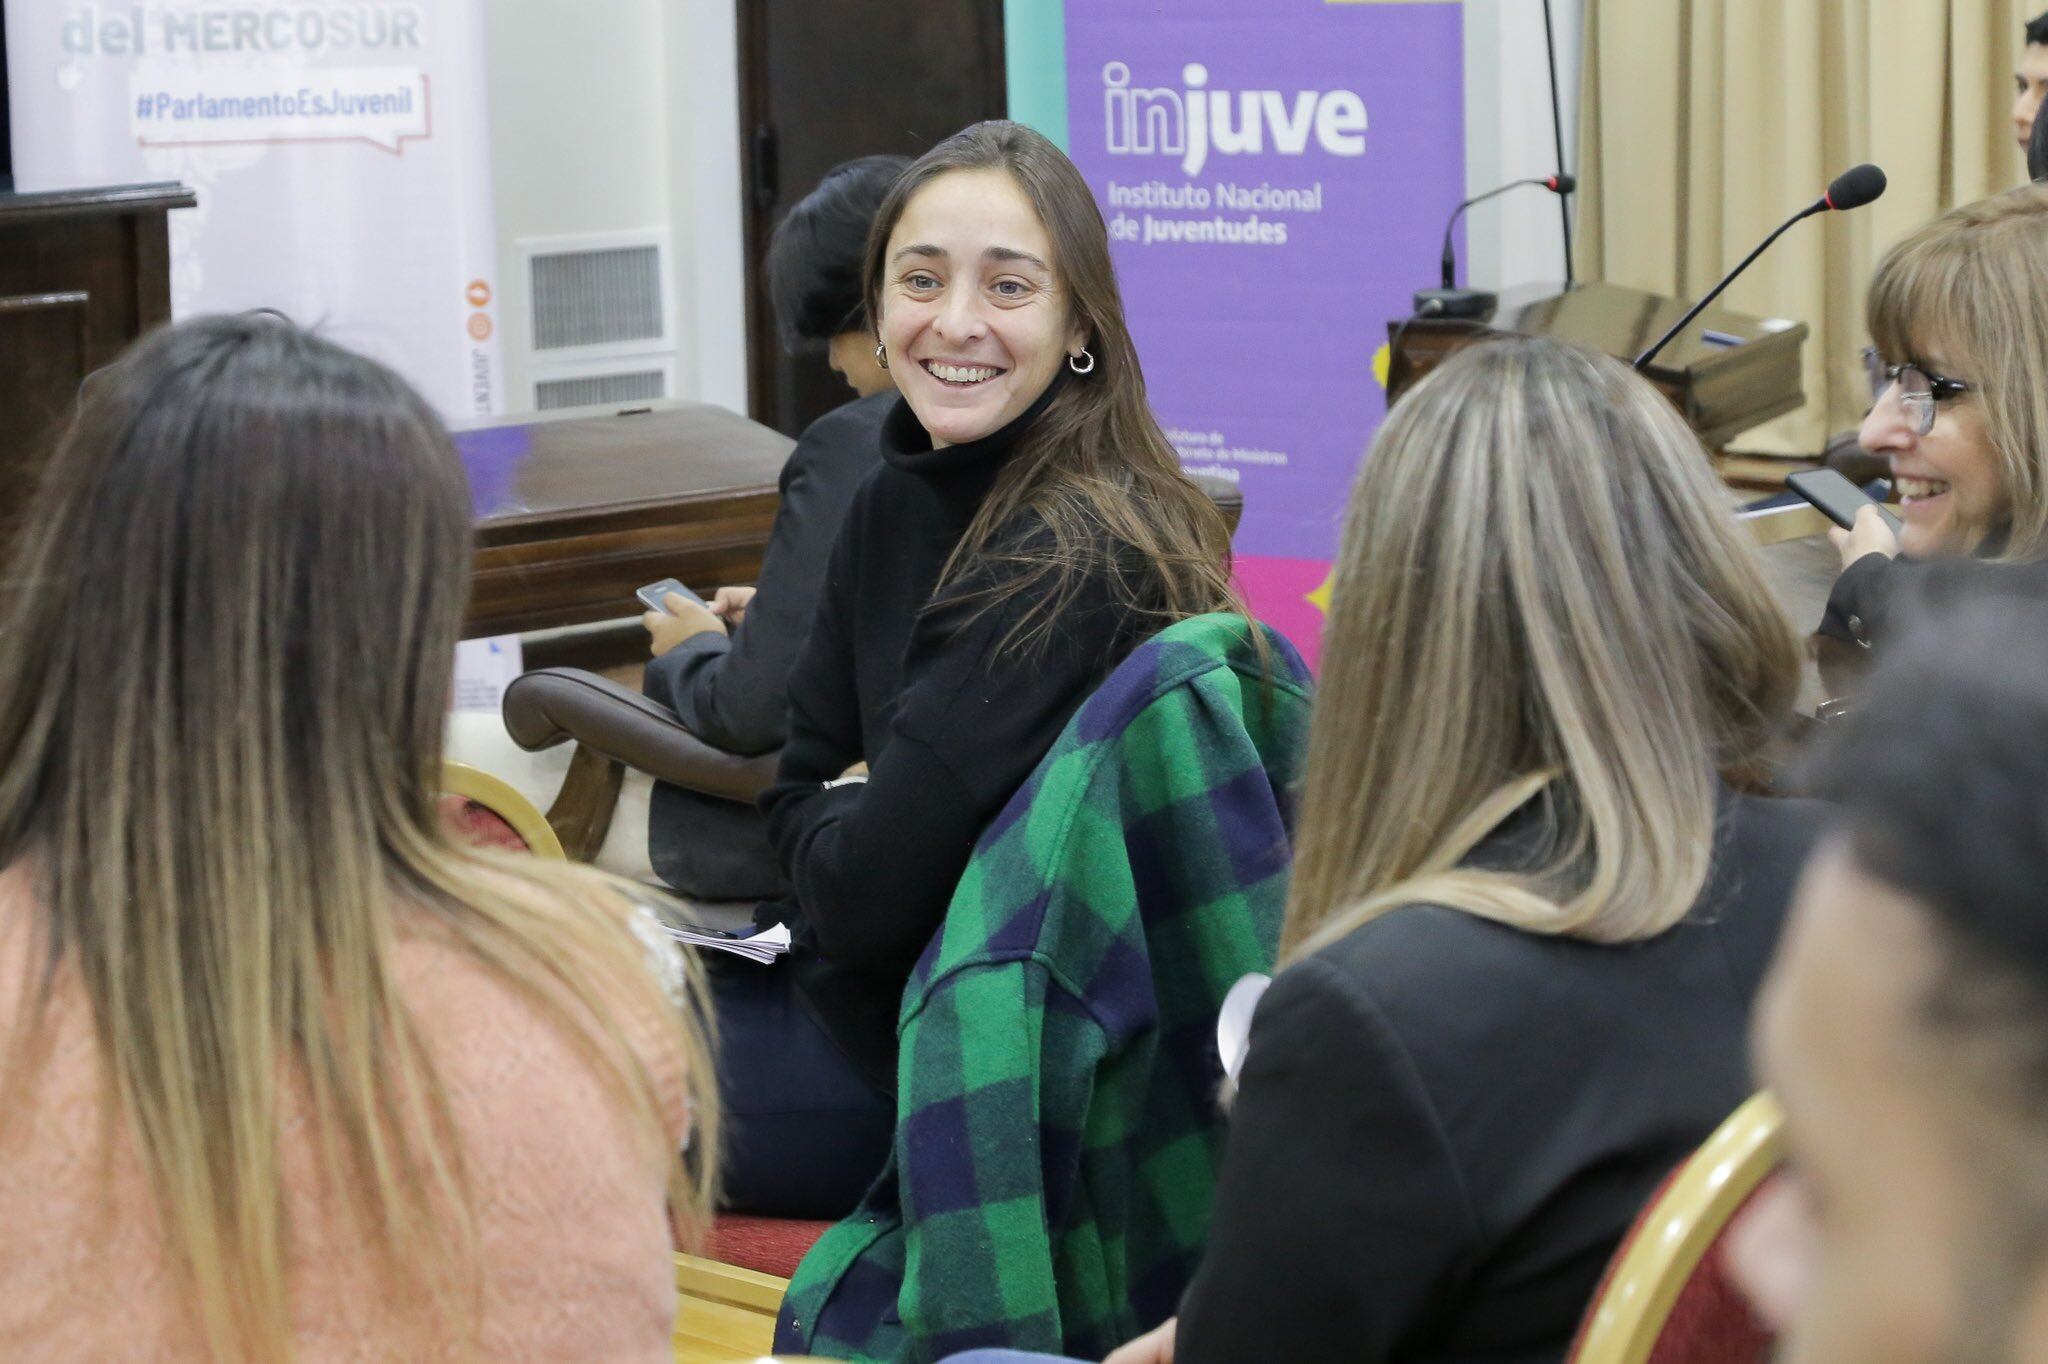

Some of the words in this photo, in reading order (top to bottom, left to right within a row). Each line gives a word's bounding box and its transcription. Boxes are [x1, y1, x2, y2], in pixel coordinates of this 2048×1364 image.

[60, 7, 144, 54] del
[163, 7, 420, 52] MERCOSUR
[136, 86, 413, 120] #ParlamentoEsJuvenil
[1102, 62, 1368, 176] injuve
[1107, 181, 1210, 209] Instituto
[1216, 182, 1322, 211] Nacional
[1110, 211, 1139, 240] de
[1144, 214, 1288, 245] Juventudes
